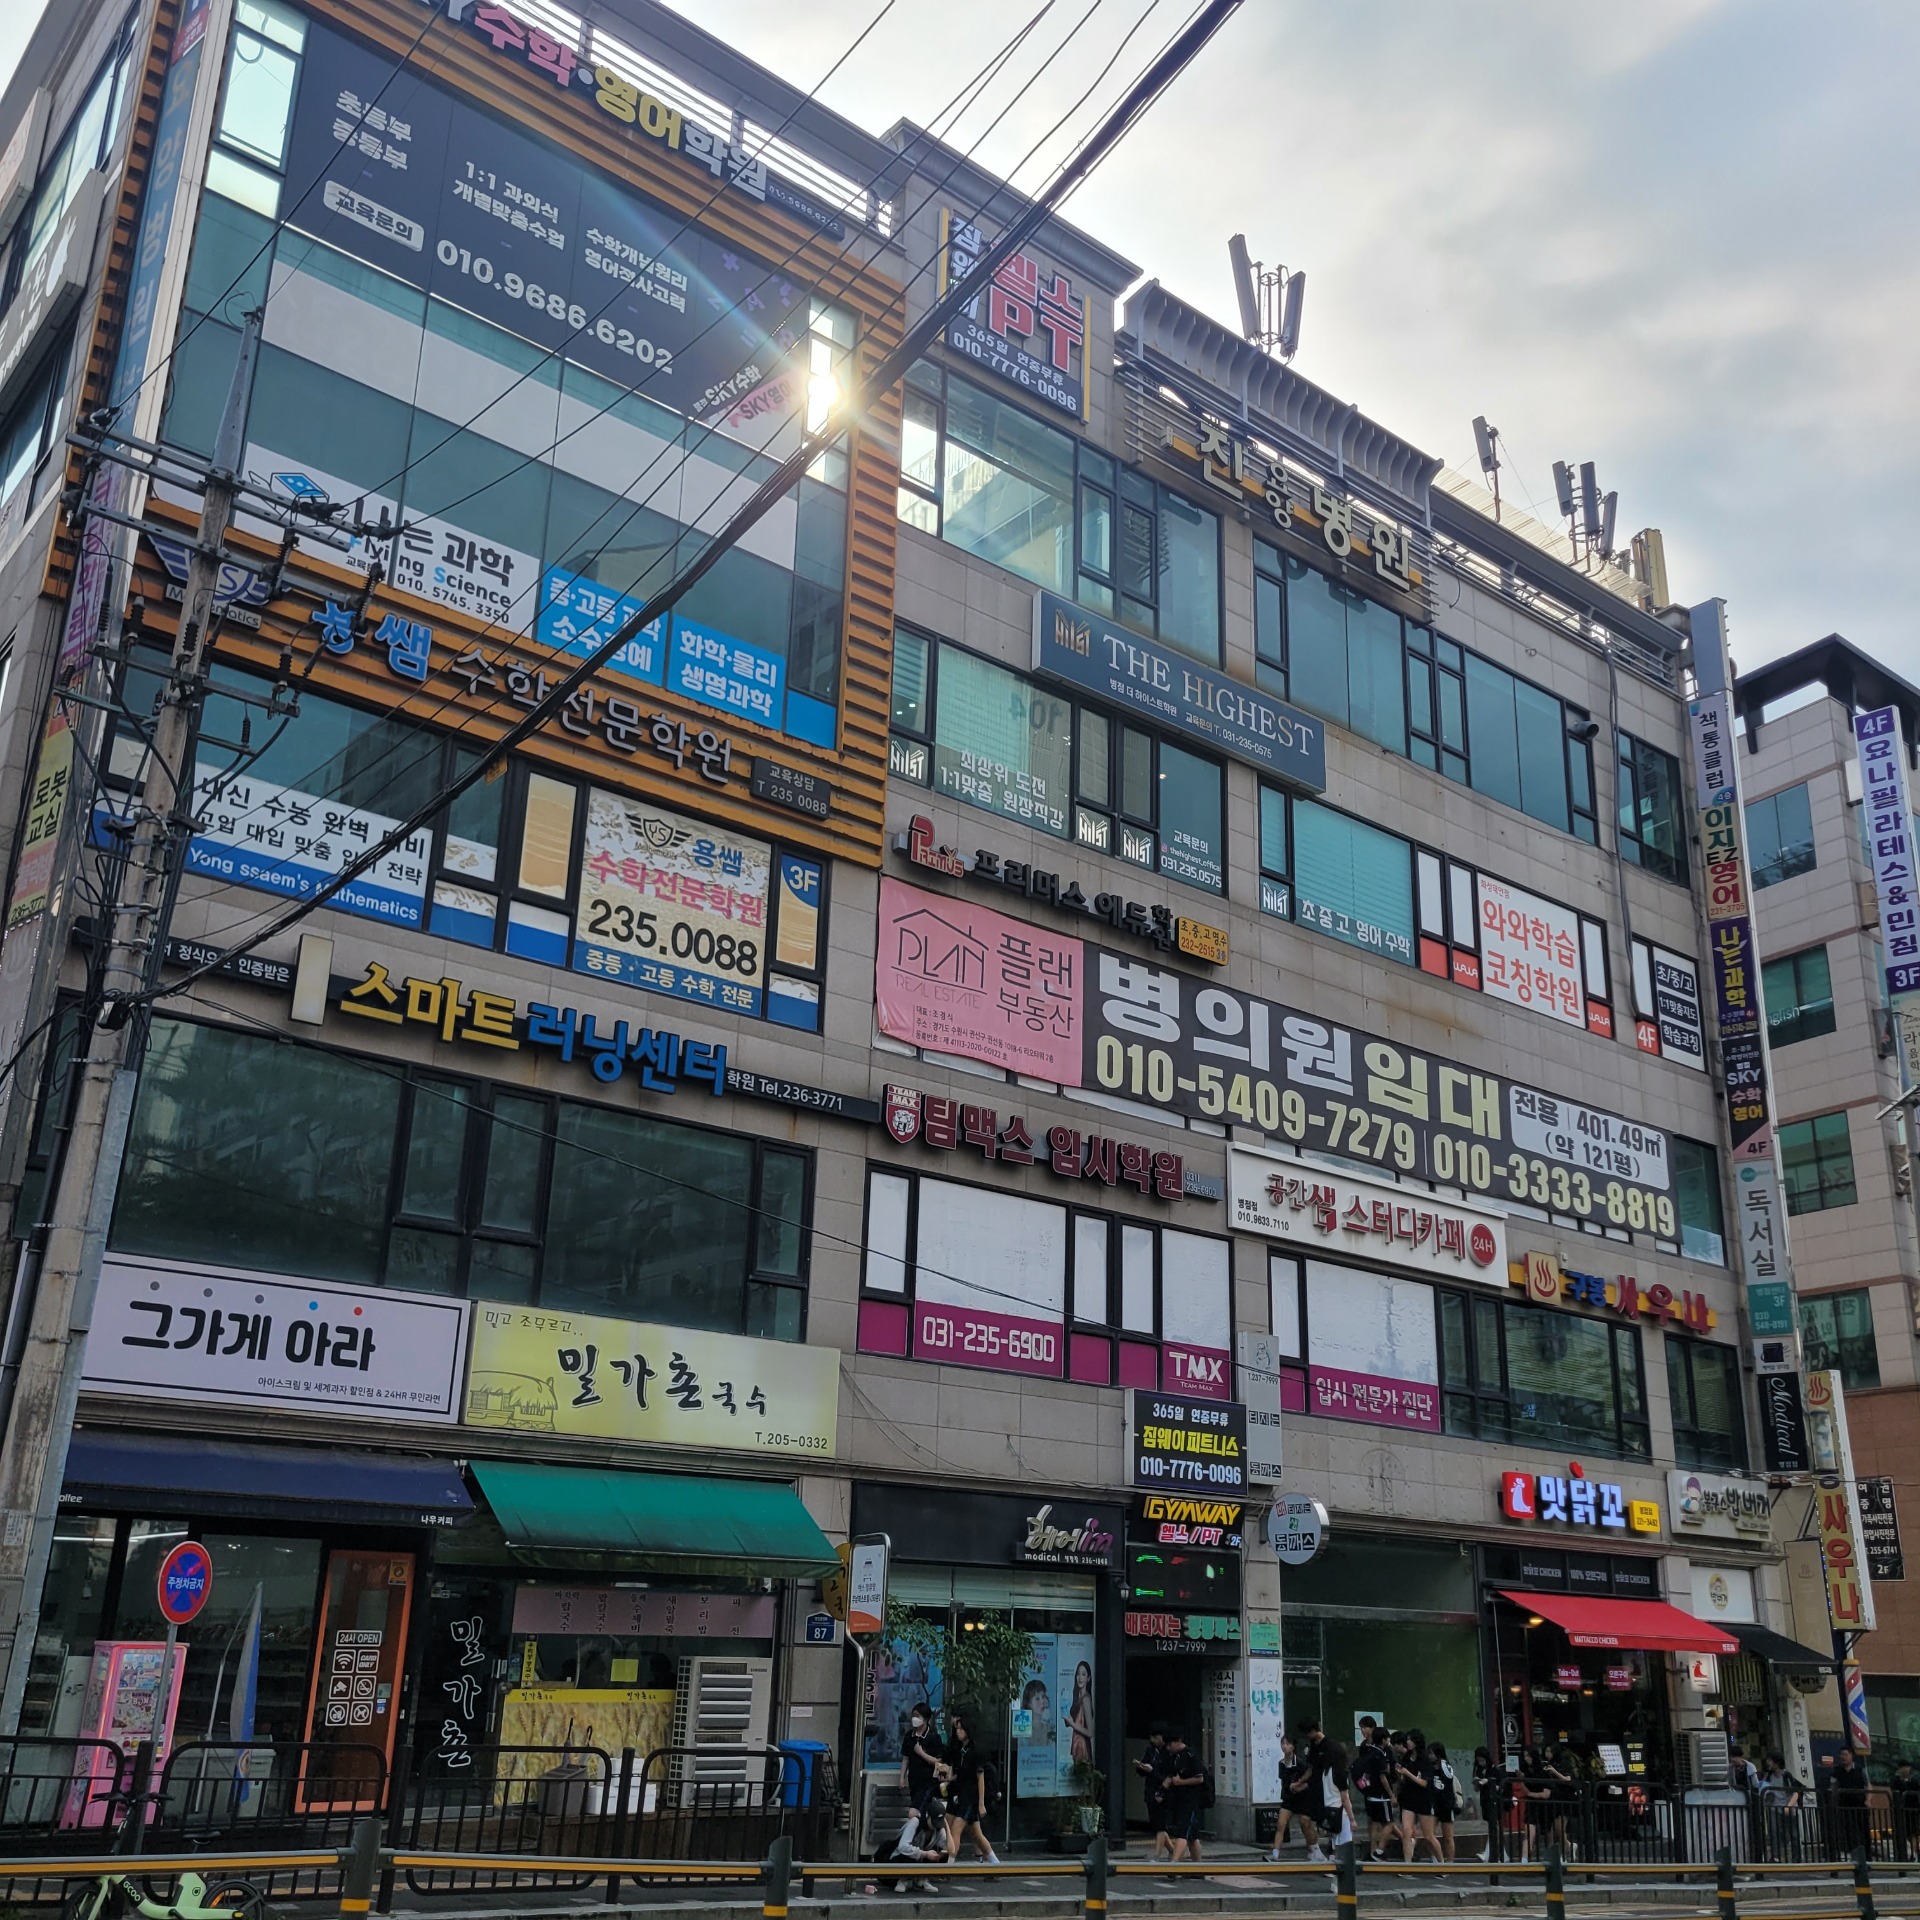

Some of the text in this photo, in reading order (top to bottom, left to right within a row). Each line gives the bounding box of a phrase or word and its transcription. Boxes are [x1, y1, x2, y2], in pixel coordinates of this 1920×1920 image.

[465, 161, 559, 224] 1:1 과외식
[335, 188, 414, 243] 교육문의
[453, 179, 566, 250] 개별맞춤수업
[584, 248, 687, 313] 영어적사고력
[586, 228, 688, 292] 수학개념원리
[437, 239, 674, 375] 010.9686.6202
[952, 331, 1078, 412] 010-7776-0096
[967, 324, 1065, 387] 365일 연중무휴
[440, 531, 516, 589] 과학
[432, 566, 513, 608] Science
[679, 629, 778, 689] 화학·물리
[680, 661, 774, 719] 생명과학
[1102, 633, 1315, 757] THE HIGHEST
[1862, 712, 1888, 735] 4F
[1697, 709, 1725, 789] 책통클럽
[769, 763, 816, 793] 교육상담
[960, 749, 1047, 801] 최상위 도전
[770, 784, 795, 803] 235
[797, 794, 828, 816] 0088
[1002, 789, 1065, 831] 원장직강
[246, 821, 423, 887] 대입 맞춤 전략
[1173, 830, 1209, 855] 교육문의
[1706, 848, 1739, 866] EZ
[588, 849, 766, 929] 수학전문학원
[789, 863, 819, 893] 3F
[974, 848, 1089, 913] 프리머스
[1161, 856, 1222, 889] 031.235.0575
[1708, 862, 1742, 905] 영어
[587, 898, 759, 977] 235.0088
[1181, 936, 1215, 958] 232-2515
[1356, 919, 1411, 959] 영어 수학
[1482, 898, 1577, 970] 와와학습
[239, 956, 291, 983] 인증받은
[897, 926, 985, 989] PLAN
[996, 932, 1074, 1001] 플랜
[585, 949, 754, 1010] 중등 고등 수학 전문
[1485, 950, 1581, 1020] 코칭학원
[996, 986, 1075, 1040] 부동산
[1637, 1024, 1657, 1049] 4F
[1662, 1024, 1700, 1053] 학습코칭
[726, 1069, 755, 1092] 학원
[891, 1087, 918, 1100] TEAM
[1726, 1068, 1762, 1087] SKY
[891, 1096, 918, 1108] MAX
[1513, 1088, 1560, 1128] 전용
[1732, 1105, 1764, 1122] 영어
[924, 1094, 1186, 1202] 팀맥스 입시학원
[1096, 1034, 1677, 1238] 010-5409-7279 010-3333-8819
[1746, 1140, 1768, 1155] 4F
[1237, 1210, 1290, 1231] 010.9633.7110
[1341, 1195, 1466, 1262] 스터디카페
[1473, 1234, 1495, 1254] 24H
[1745, 1188, 1778, 1278] 독서실
[1613, 1274, 1713, 1335] 사우나
[121, 1299, 377, 1372] 그가게 아라
[921, 1315, 1055, 1363] 031-235-6900
[256, 1376, 301, 1392] 아이스크림
[313, 1382, 348, 1397] 세계과자
[349, 1385, 375, 1399] 할인점
[383, 1389, 408, 1402] 24HR
[408, 1391, 442, 1405] 무인라면
[557, 1344, 767, 1416] 밀가촌 국수
[1180, 1381, 1214, 1392] TEAM MAX
[1315, 1376, 1433, 1421] 입시 전문가 집단
[1152, 1402, 1230, 1428] 365일 연중무휴
[754, 1431, 829, 1450] T.205-0332
[1140, 1455, 1242, 1486] 010-7776-0096
[420, 1514, 454, 1527] 나우커피
[1142, 1495, 1242, 1527] GYMWAY
[1537, 1475, 1627, 1529] 맛닭꼬
[1158, 1523, 1224, 1546] 헬스 PT
[1539, 1568, 1562, 1579] CHICKEN
[1629, 1574, 1651, 1585] CHICKEN
[1822, 1493, 1862, 1624] 사우나
[167, 1575, 205, 1592] 주정차금지
[339, 1632, 379, 1644] 24시 OPEN
[814, 1627, 827, 1640] 87
[1124, 1612, 1181, 1638] 배터지는
[1155, 1637, 1207, 1654] T.237-7999
[437, 1614, 486, 1769] 밀가촌
[1557, 1667, 1580, 1678] Take-Out
[121, 1879, 142, 1904] GCOO
